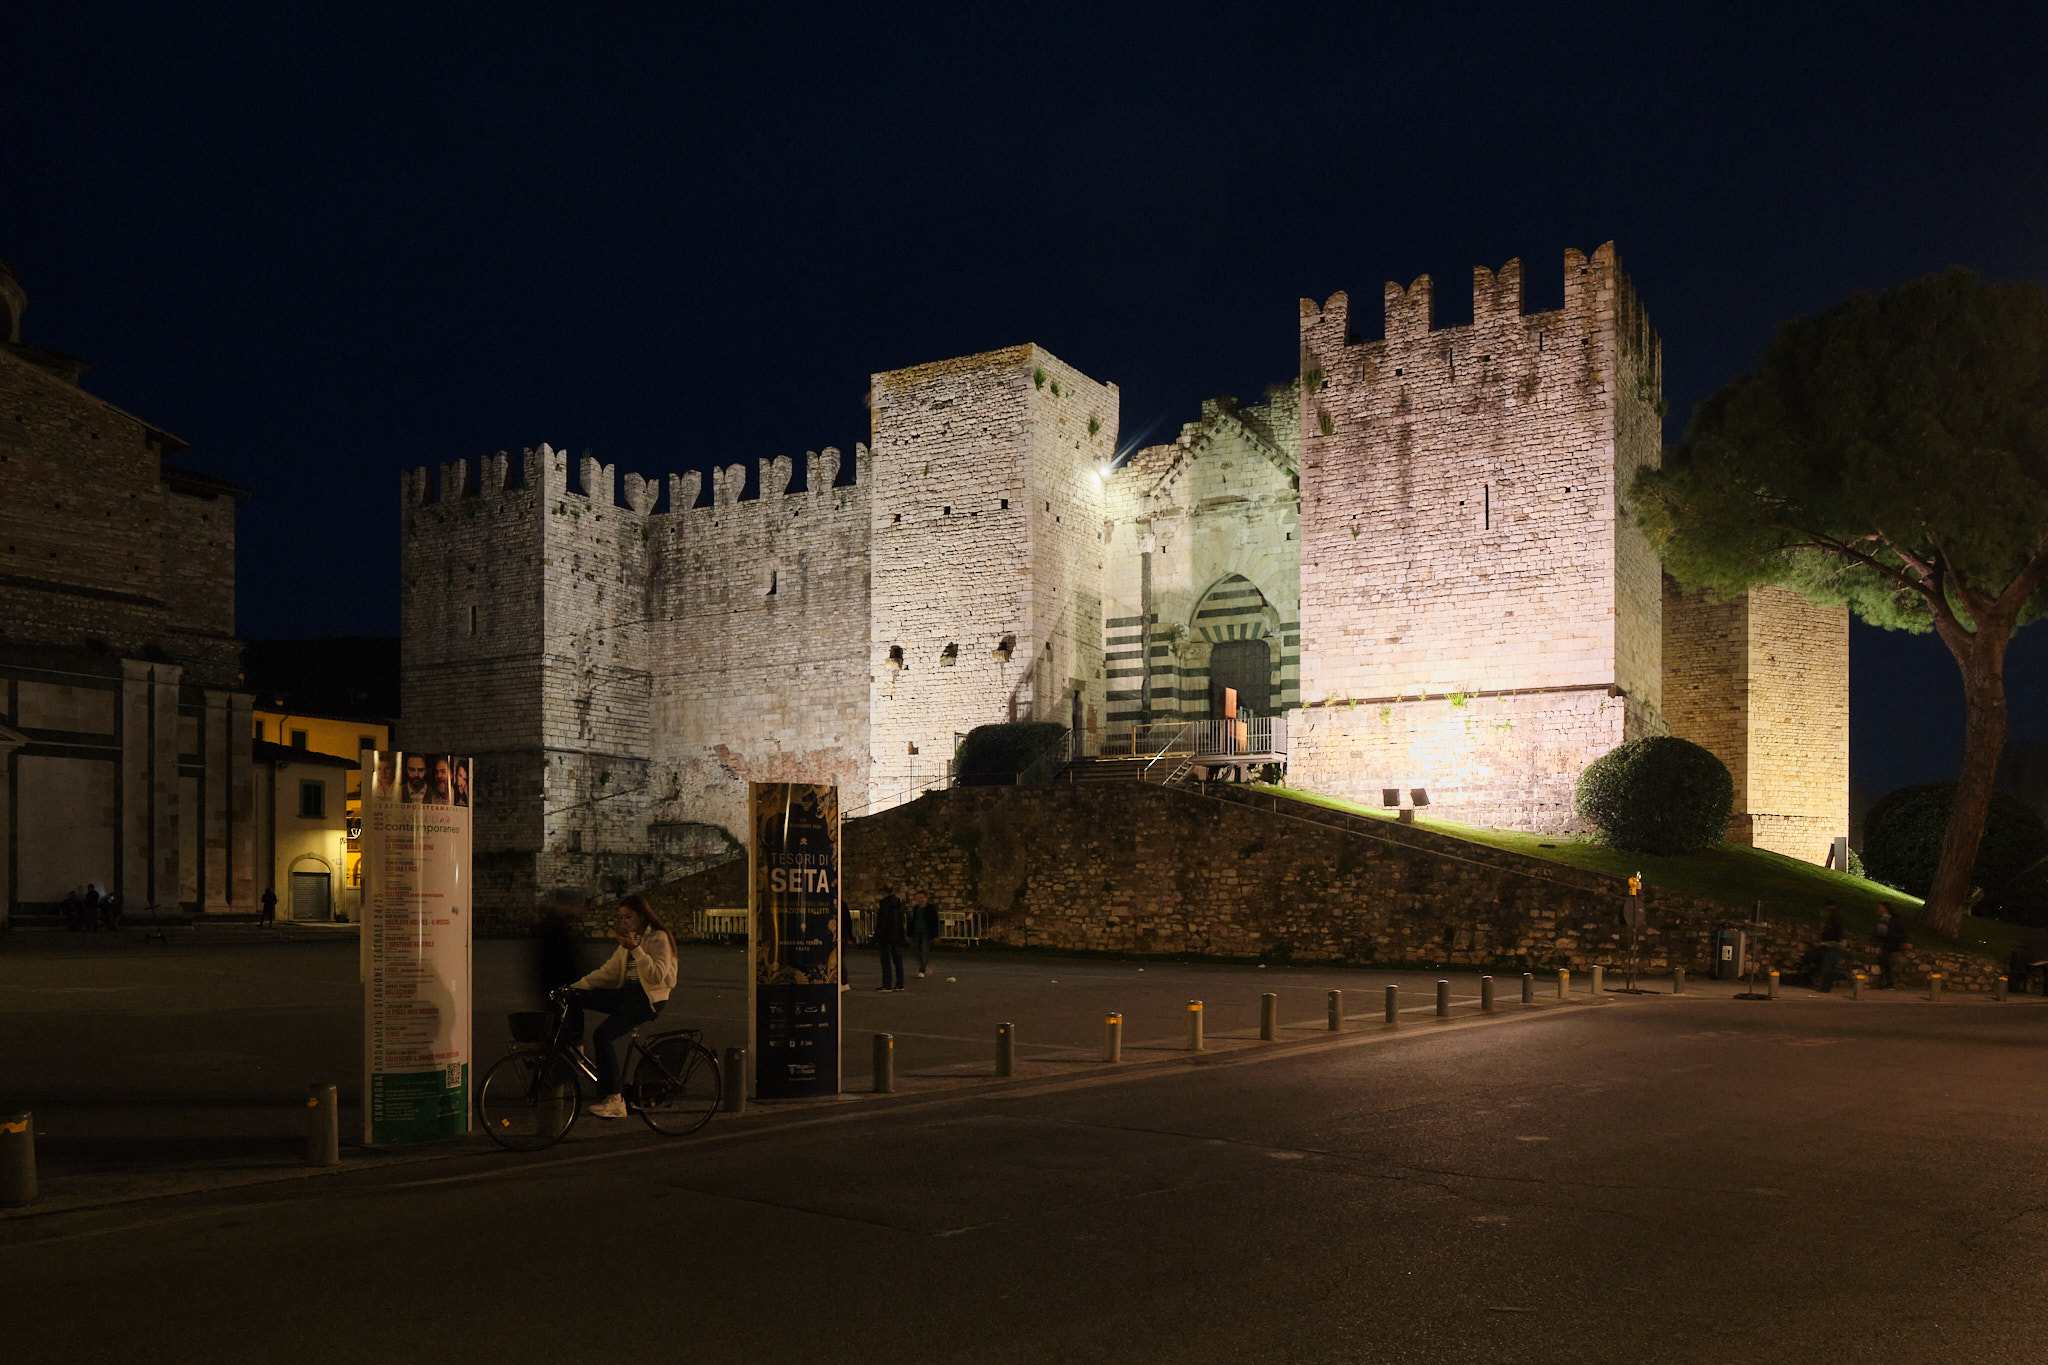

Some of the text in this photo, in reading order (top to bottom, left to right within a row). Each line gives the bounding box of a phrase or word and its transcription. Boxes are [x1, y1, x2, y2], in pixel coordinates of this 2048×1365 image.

[374, 812, 384, 831] 2025
[385, 813, 438, 824] CLASSCO
[385, 823, 460, 834] contemporaneo
[770, 853, 829, 866] TESORI DI
[771, 867, 830, 893] SETA
[374, 893, 384, 1122] CAMPAGNA ABBONAMENTI STAGIONE TEATRALE 24/25
